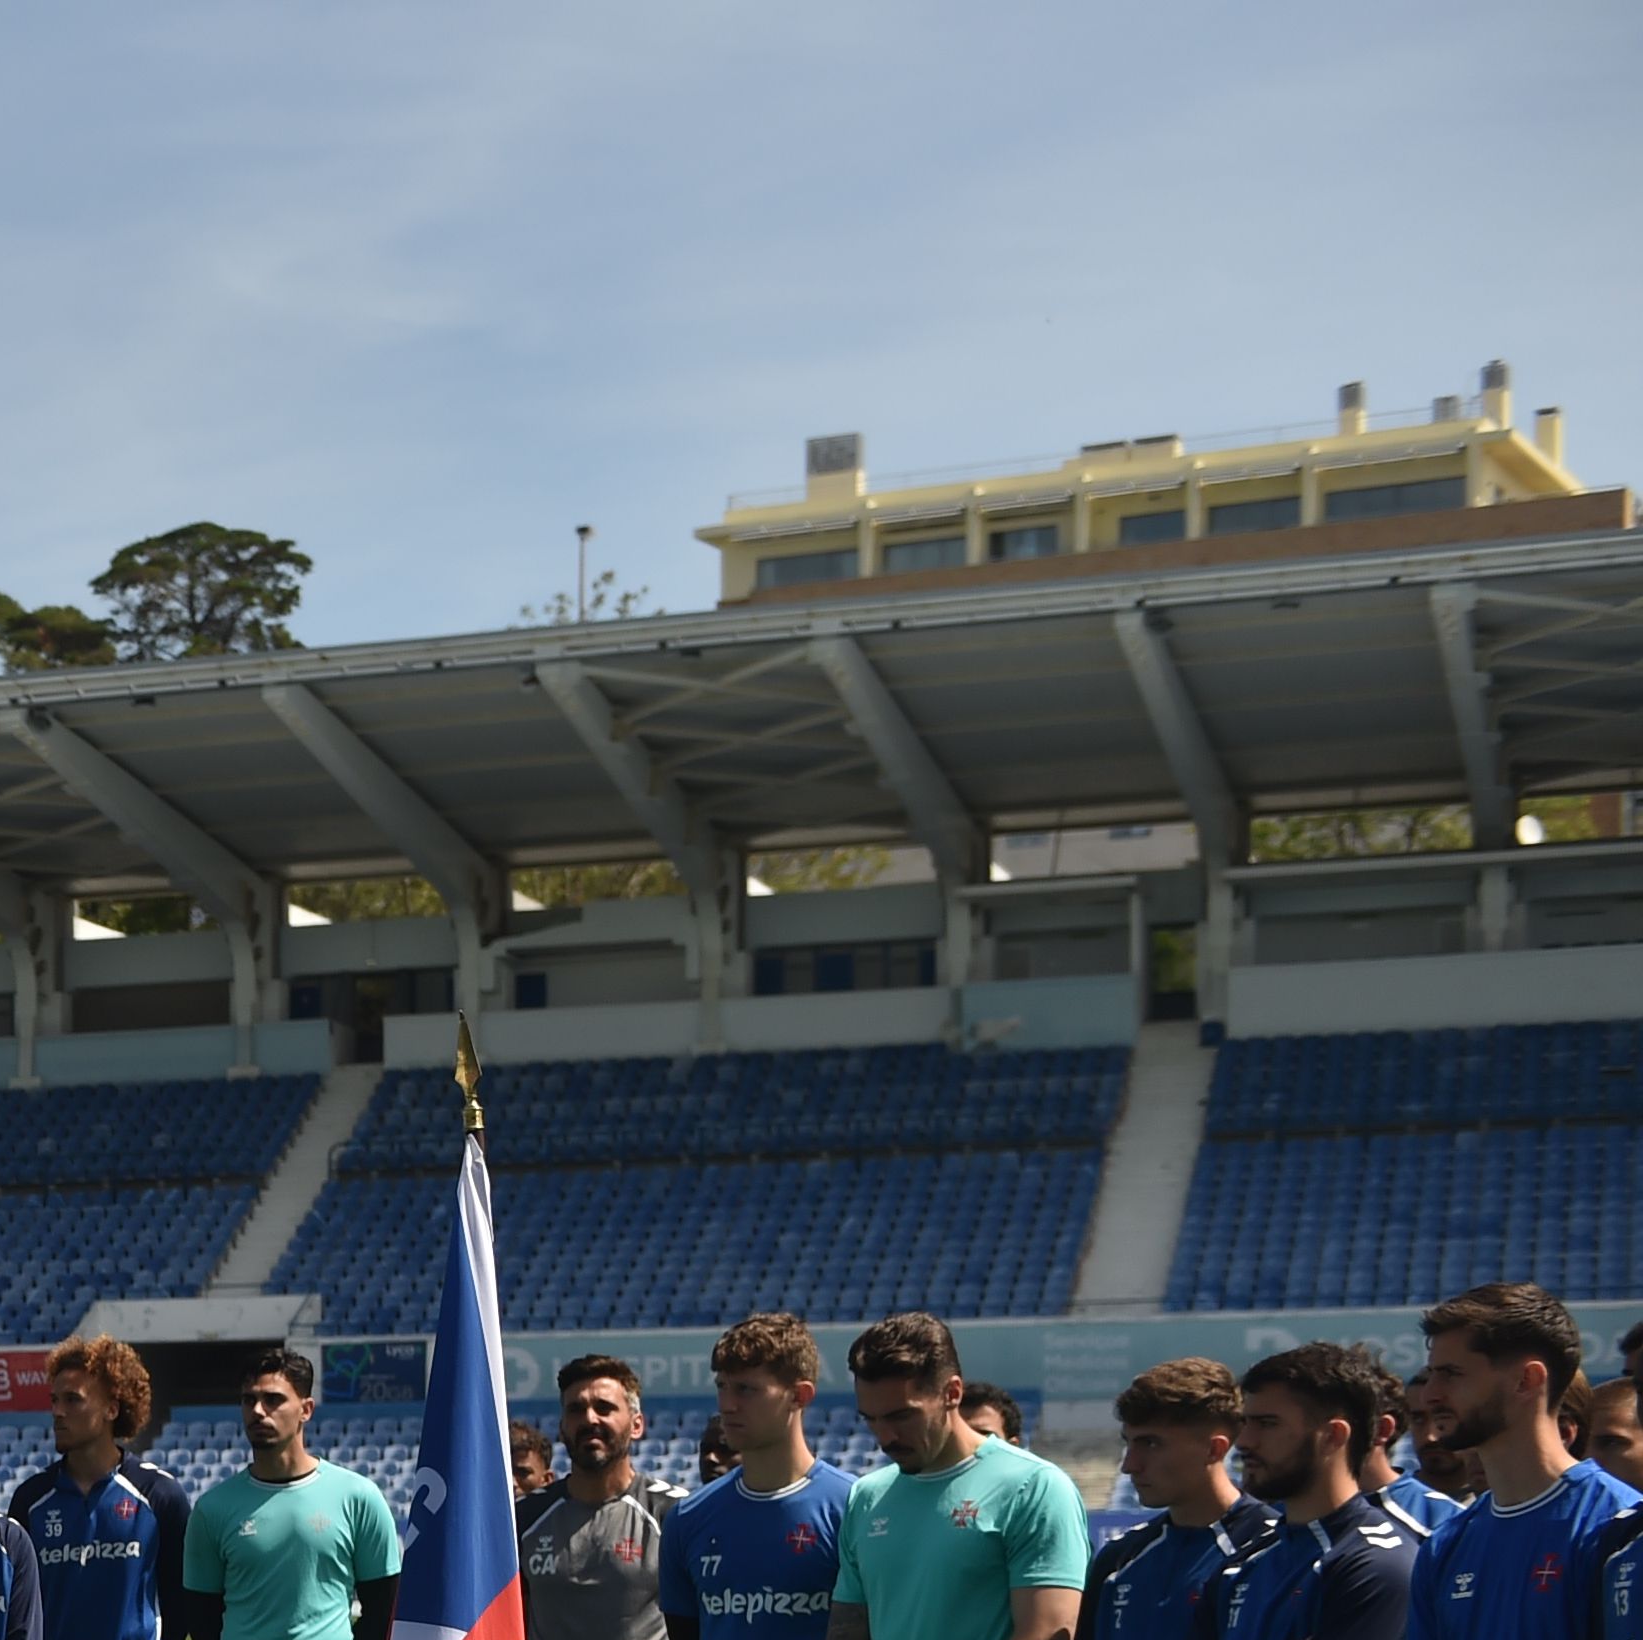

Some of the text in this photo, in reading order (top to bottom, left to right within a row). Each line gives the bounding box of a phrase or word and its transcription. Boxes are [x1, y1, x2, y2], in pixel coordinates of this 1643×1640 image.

[16, 1371, 49, 1386] WAY
[45, 1523, 63, 1538] 39
[40, 1540, 140, 1566] telepizza
[700, 1555, 722, 1577] 77
[703, 1587, 830, 1624] telepizza
